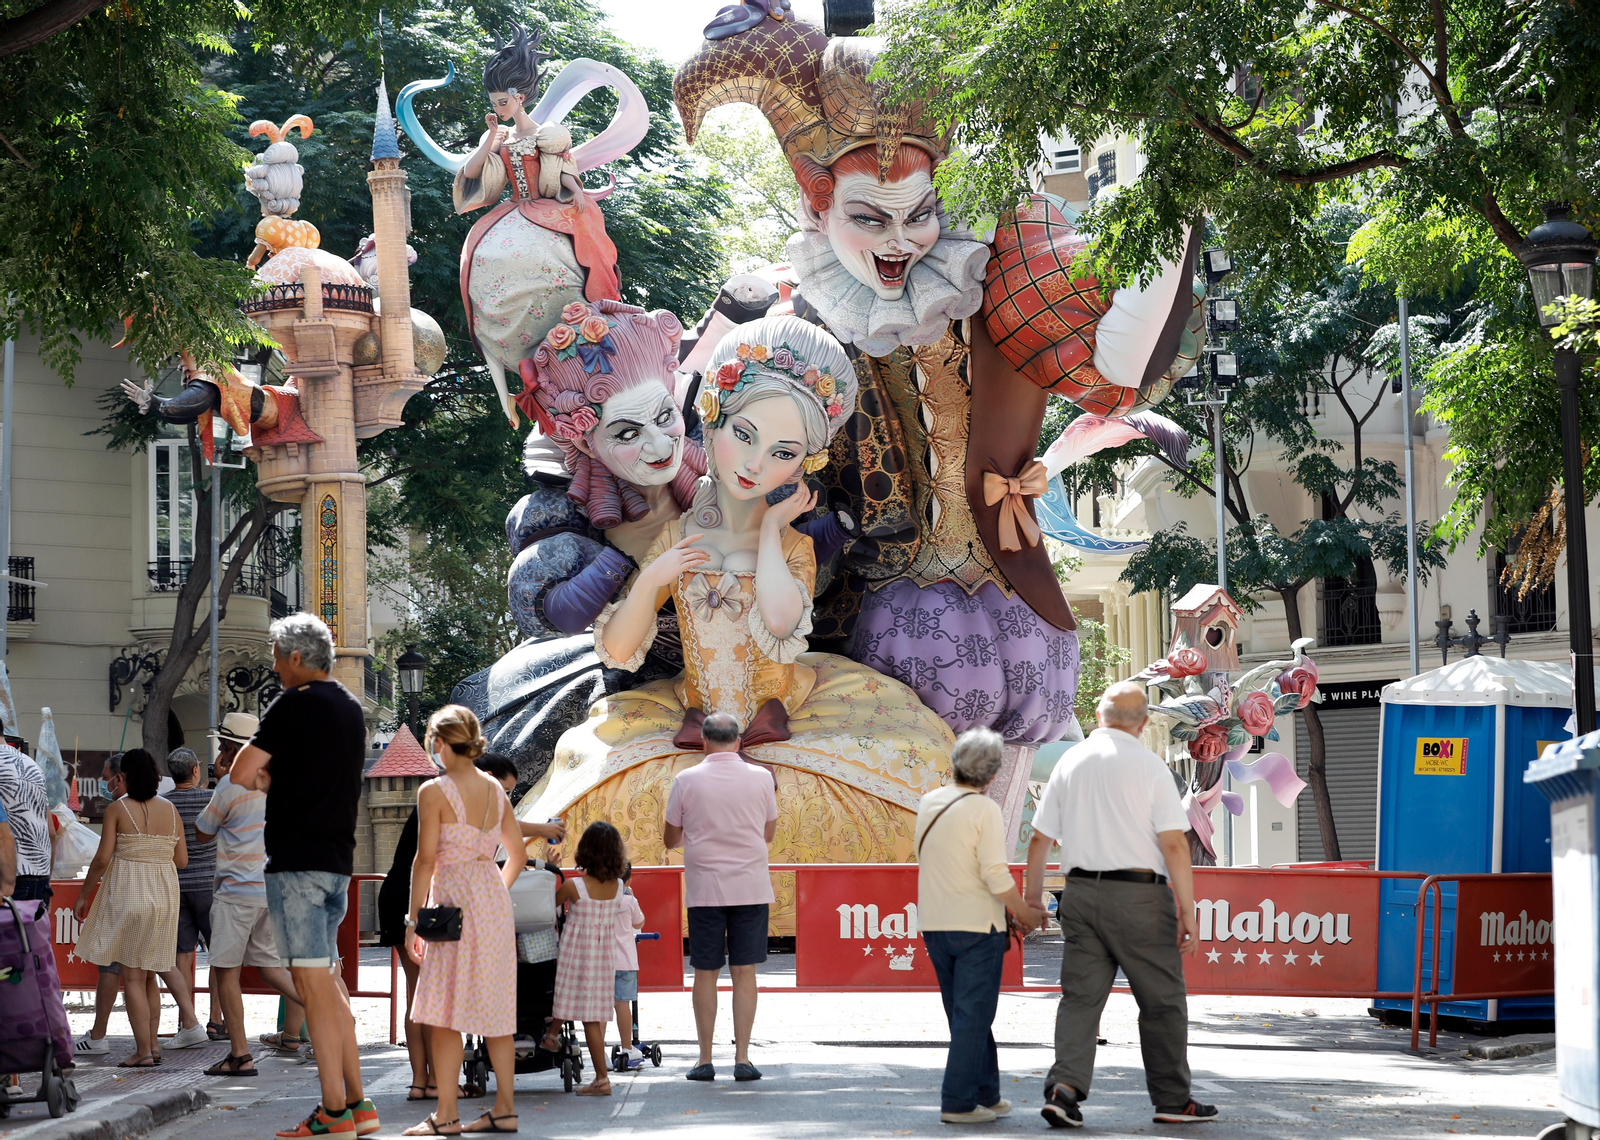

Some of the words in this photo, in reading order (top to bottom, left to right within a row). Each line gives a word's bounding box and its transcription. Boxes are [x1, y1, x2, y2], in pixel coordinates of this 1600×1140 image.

[1331, 691, 1357, 701] WINE
[1361, 690, 1381, 699] PLA
[1423, 740, 1454, 759] BOXI
[1194, 898, 1352, 944] Mahou
